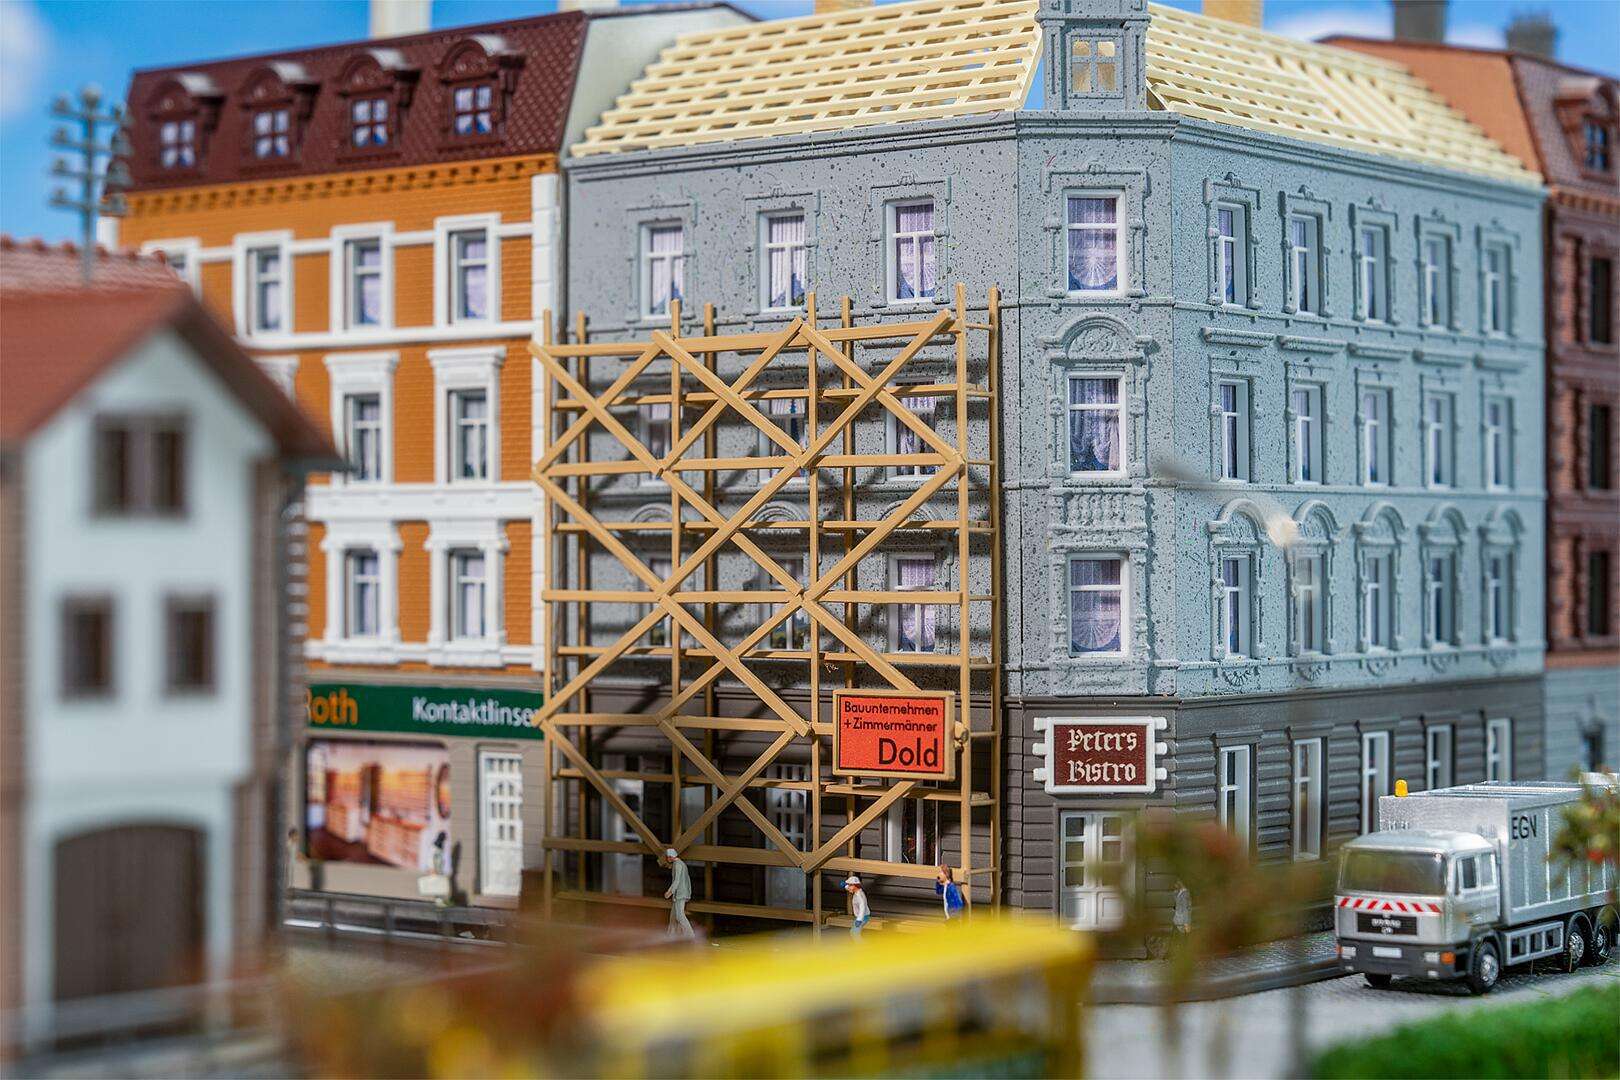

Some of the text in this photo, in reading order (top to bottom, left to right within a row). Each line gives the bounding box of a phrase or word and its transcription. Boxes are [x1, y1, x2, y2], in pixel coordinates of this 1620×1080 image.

[412, 696, 540, 728] Kontaktlinse
[844, 701, 939, 716] Bauunternehmen
[879, 737, 938, 767] Dold
[1067, 729, 1137, 752] Peters
[1067, 758, 1136, 782] Bistro
[1511, 815, 1537, 839] EGN
